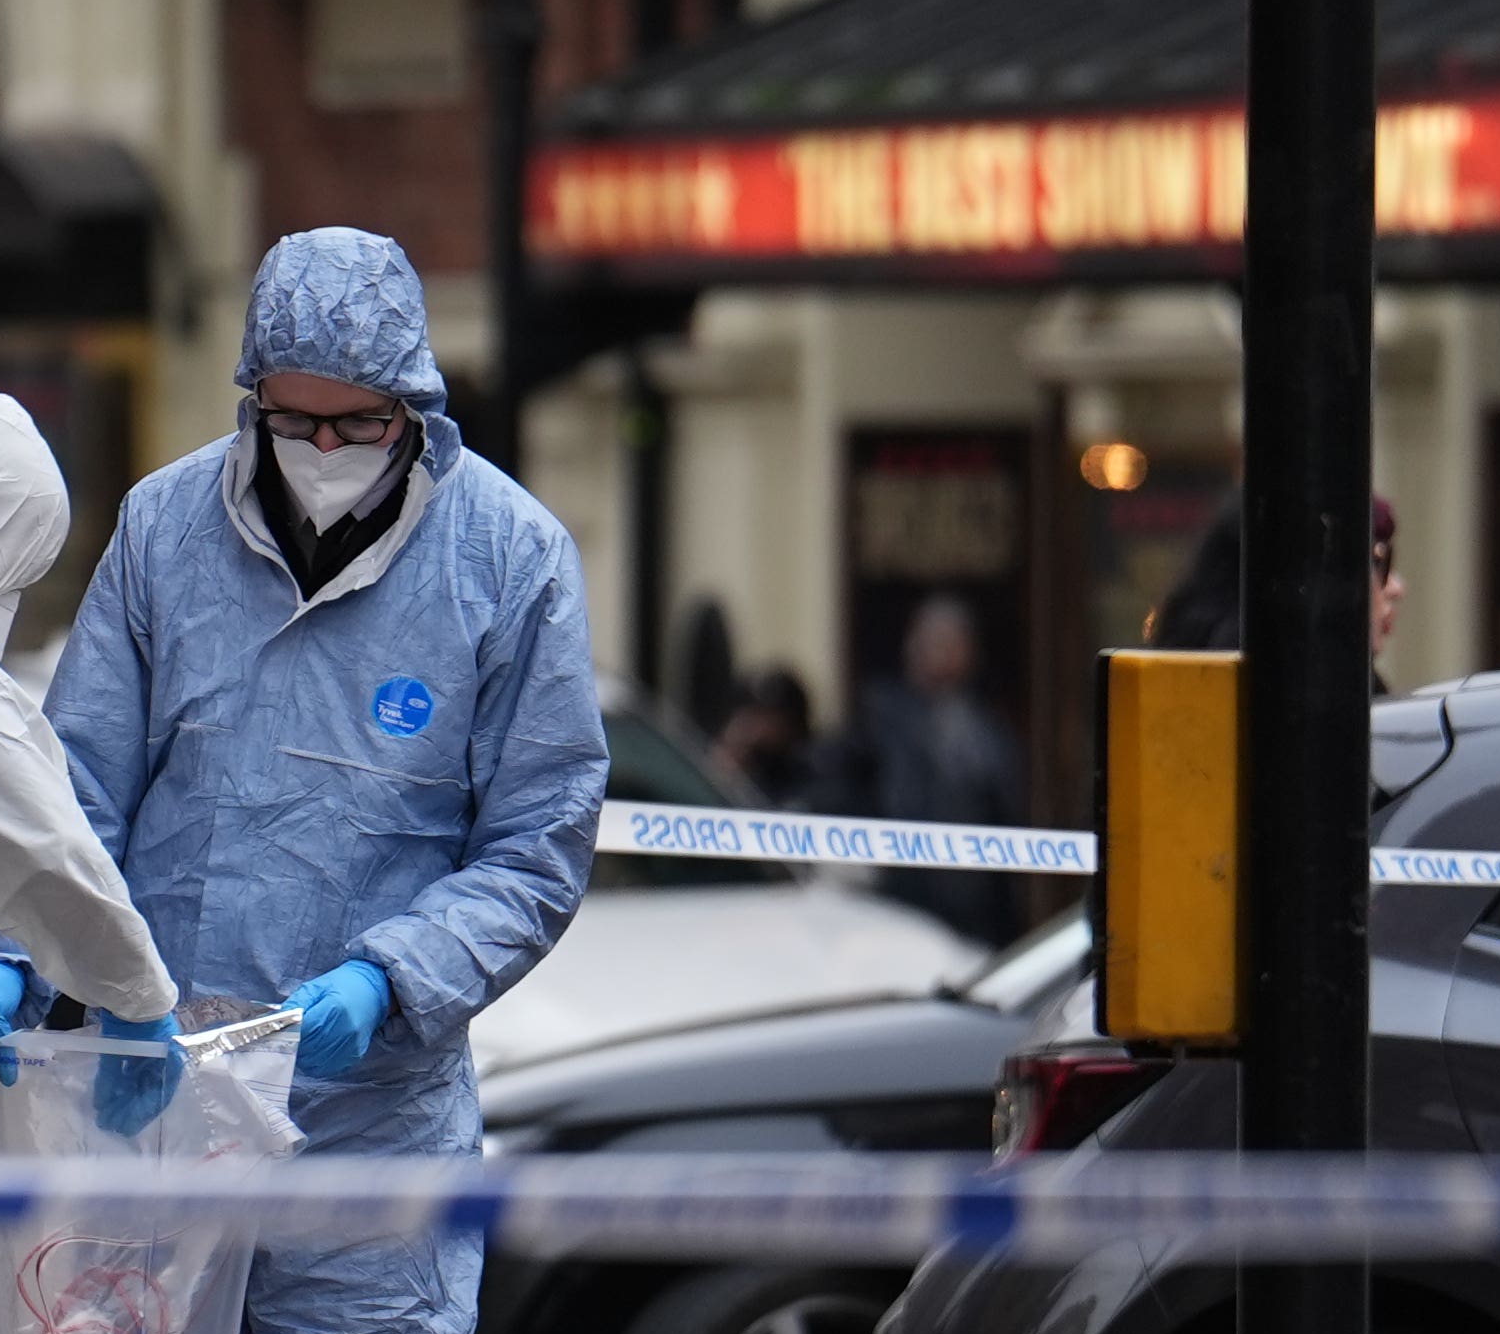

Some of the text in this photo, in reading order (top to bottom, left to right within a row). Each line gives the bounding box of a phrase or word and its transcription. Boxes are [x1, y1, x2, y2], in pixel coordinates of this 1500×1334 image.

[901, 123, 1028, 252] BEST
[1040, 117, 1196, 249] SHOW
[23, 1058, 46, 1067] TAPE
